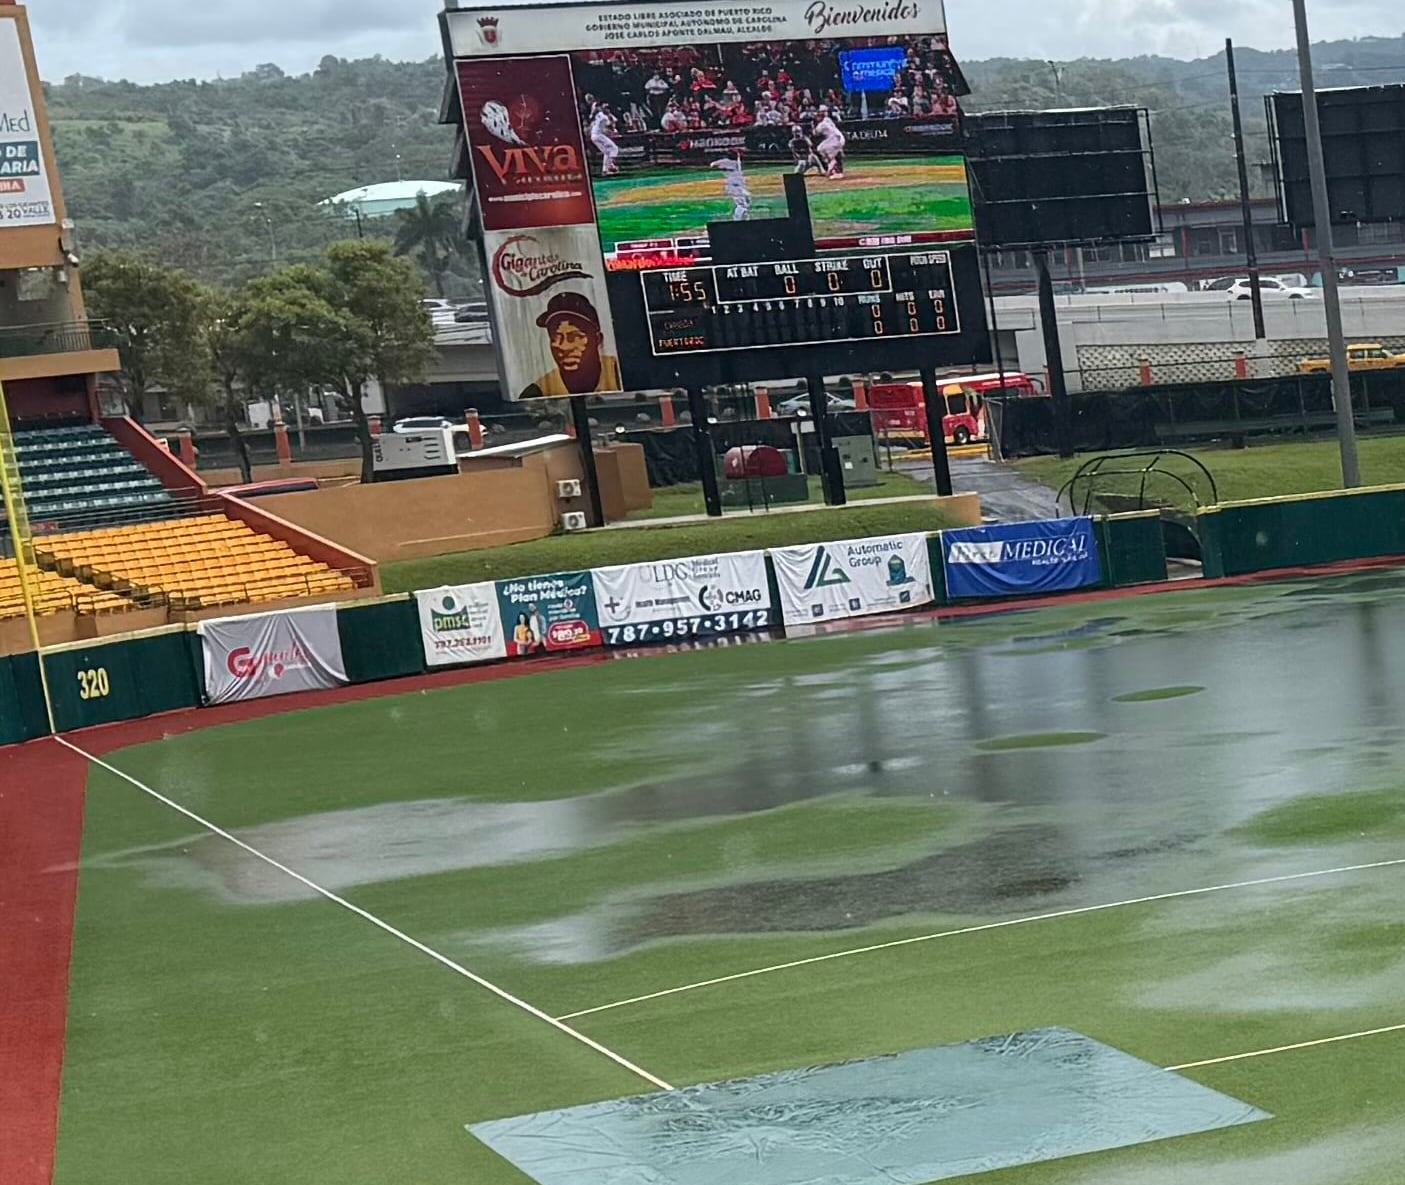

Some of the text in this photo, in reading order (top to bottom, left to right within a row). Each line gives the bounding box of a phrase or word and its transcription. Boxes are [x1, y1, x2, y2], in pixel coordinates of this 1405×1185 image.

[598, 7, 773, 21] ESTADO LIBRE ASOCIADO DE PUERTO RICO
[745, 16, 787, 24] CAROLINA
[805, 1, 919, 34] Bienvenidos
[626, 30, 660, 39] CARLOS
[661, 28, 695, 37] APONTE
[6, 145, 27, 158] DE
[775, 263, 799, 275] BALL
[815, 260, 849, 272] STRIKE
[863, 258, 881, 269] OUT
[529, 262, 583, 282] Carolina
[663, 271, 688, 283] TIME
[727, 266, 759, 278] AT BAT
[870, 269, 882, 288] 0
[784, 276, 796, 294] 0
[827, 273, 840, 291] 0
[669, 282, 707, 302] 1:55
[712, 306, 716, 314] 1
[834, 297, 844, 306] 10
[871, 304, 880, 317] 0
[908, 301, 917, 315] 0
[934, 299, 943, 313] 0
[874, 320, 883, 334] 0
[910, 318, 918, 332] 0
[936, 316, 945, 329] 0
[847, 541, 904, 556] Automatic
[1003, 535, 1085, 561] MEDICAL
[849, 556, 882, 567] Group
[511, 593, 538, 603] Plan
[725, 589, 762, 604] CMAG
[77, 668, 109, 699] 320
